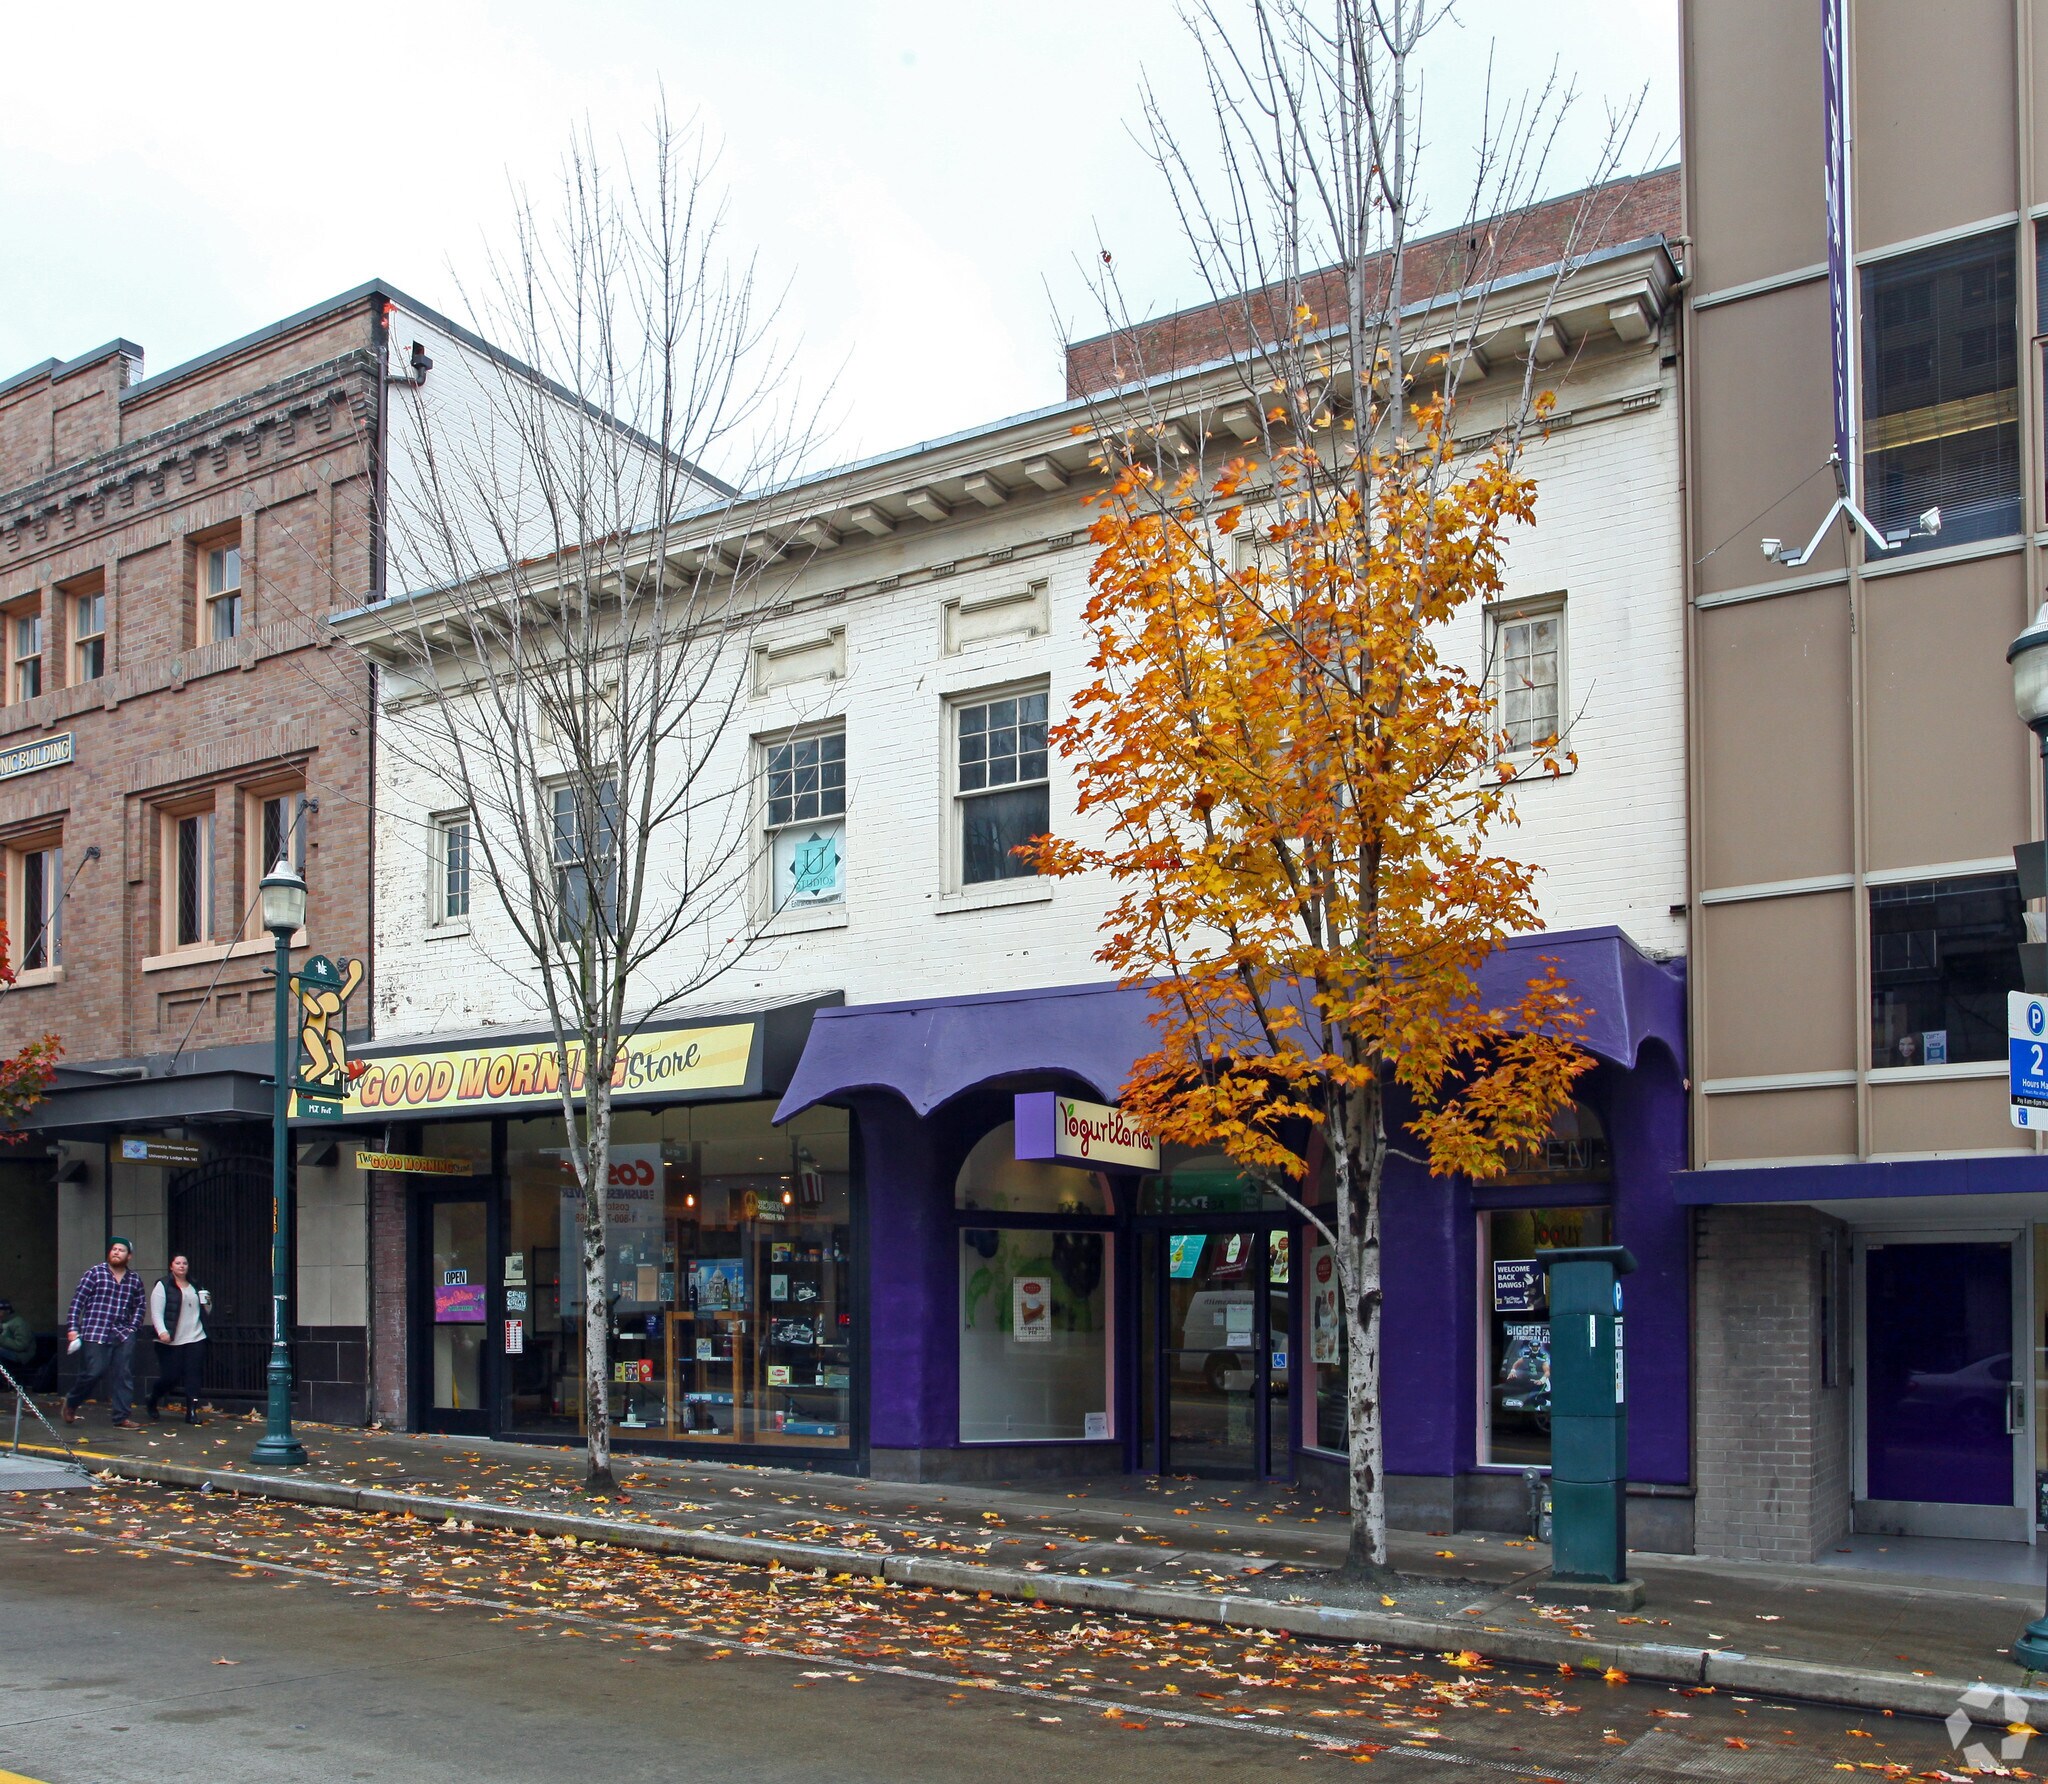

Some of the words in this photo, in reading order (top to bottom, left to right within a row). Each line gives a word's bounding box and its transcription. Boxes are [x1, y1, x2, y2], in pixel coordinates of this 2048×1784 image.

[19, 740, 69, 770] BUILDING
[2030, 1044, 2044, 1076] 2
[360, 1057, 455, 1107] GOOD
[457, 1045, 630, 1101] MORNIG
[626, 1040, 701, 1090] Store
[2022, 1078, 2040, 1089] Hours
[1060, 1101, 1154, 1157] Yogurtland
[371, 1154, 403, 1170] GOOD
[404, 1157, 453, 1174] MORNING
[445, 1270, 466, 1285] OPEN
[1497, 1265, 1530, 1273] WELCOME
[1497, 1281, 1525, 1289] DAWGS!
[1507, 1325, 1541, 1336] BIGGER
